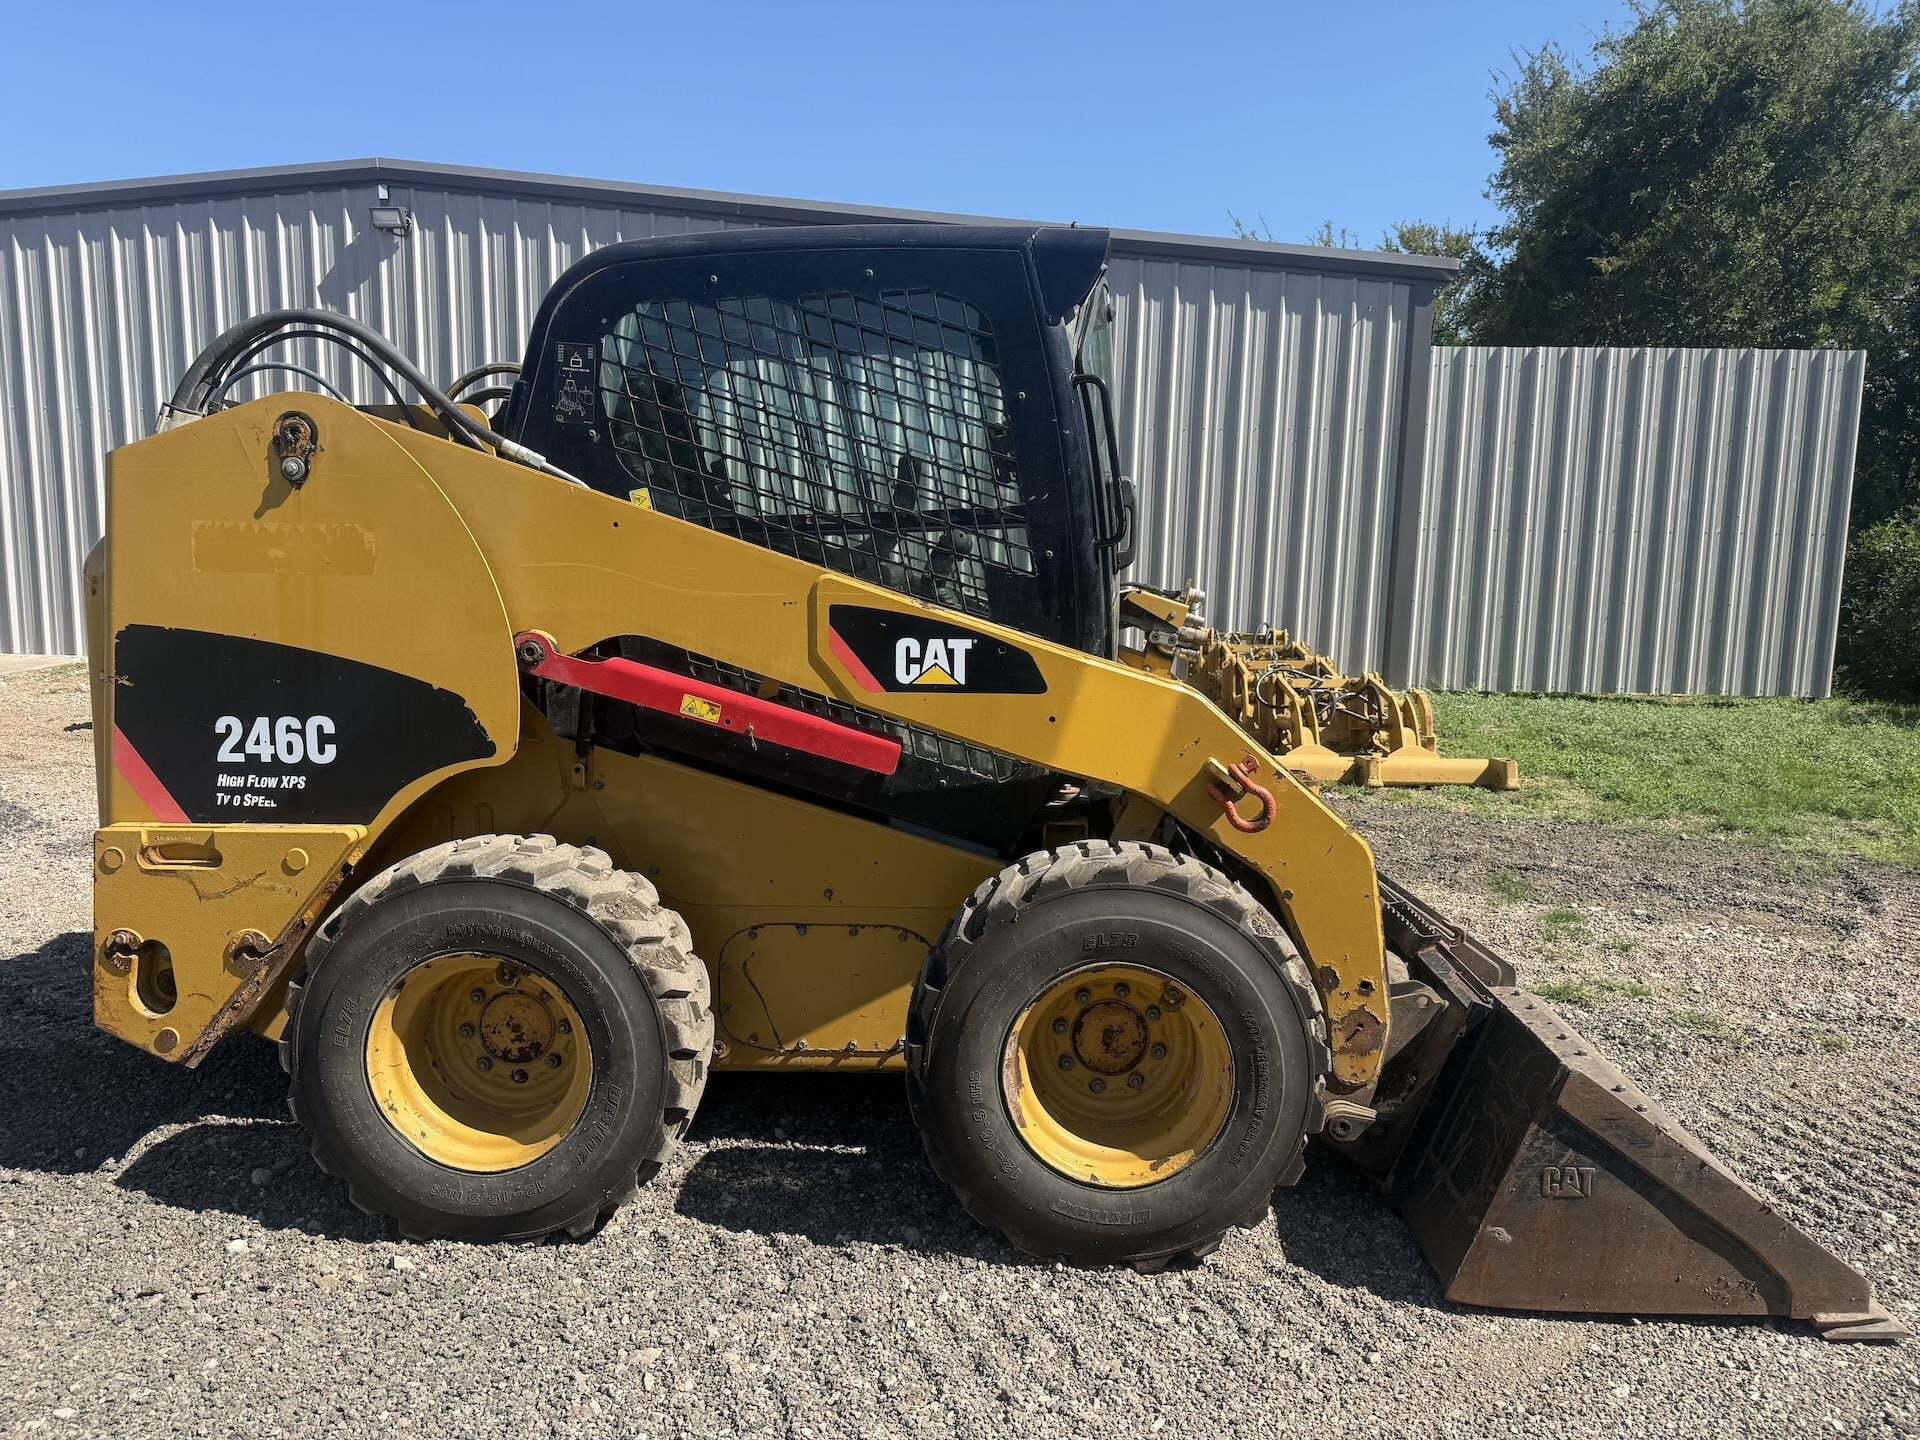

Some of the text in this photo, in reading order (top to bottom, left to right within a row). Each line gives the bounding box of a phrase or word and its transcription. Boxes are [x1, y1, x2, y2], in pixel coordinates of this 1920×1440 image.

[895, 637, 973, 685] CAT
[215, 715, 337, 764] 246C
[217, 774, 307, 789] HIGH FLOW XPS
[1542, 1166, 1596, 1199] CAT
